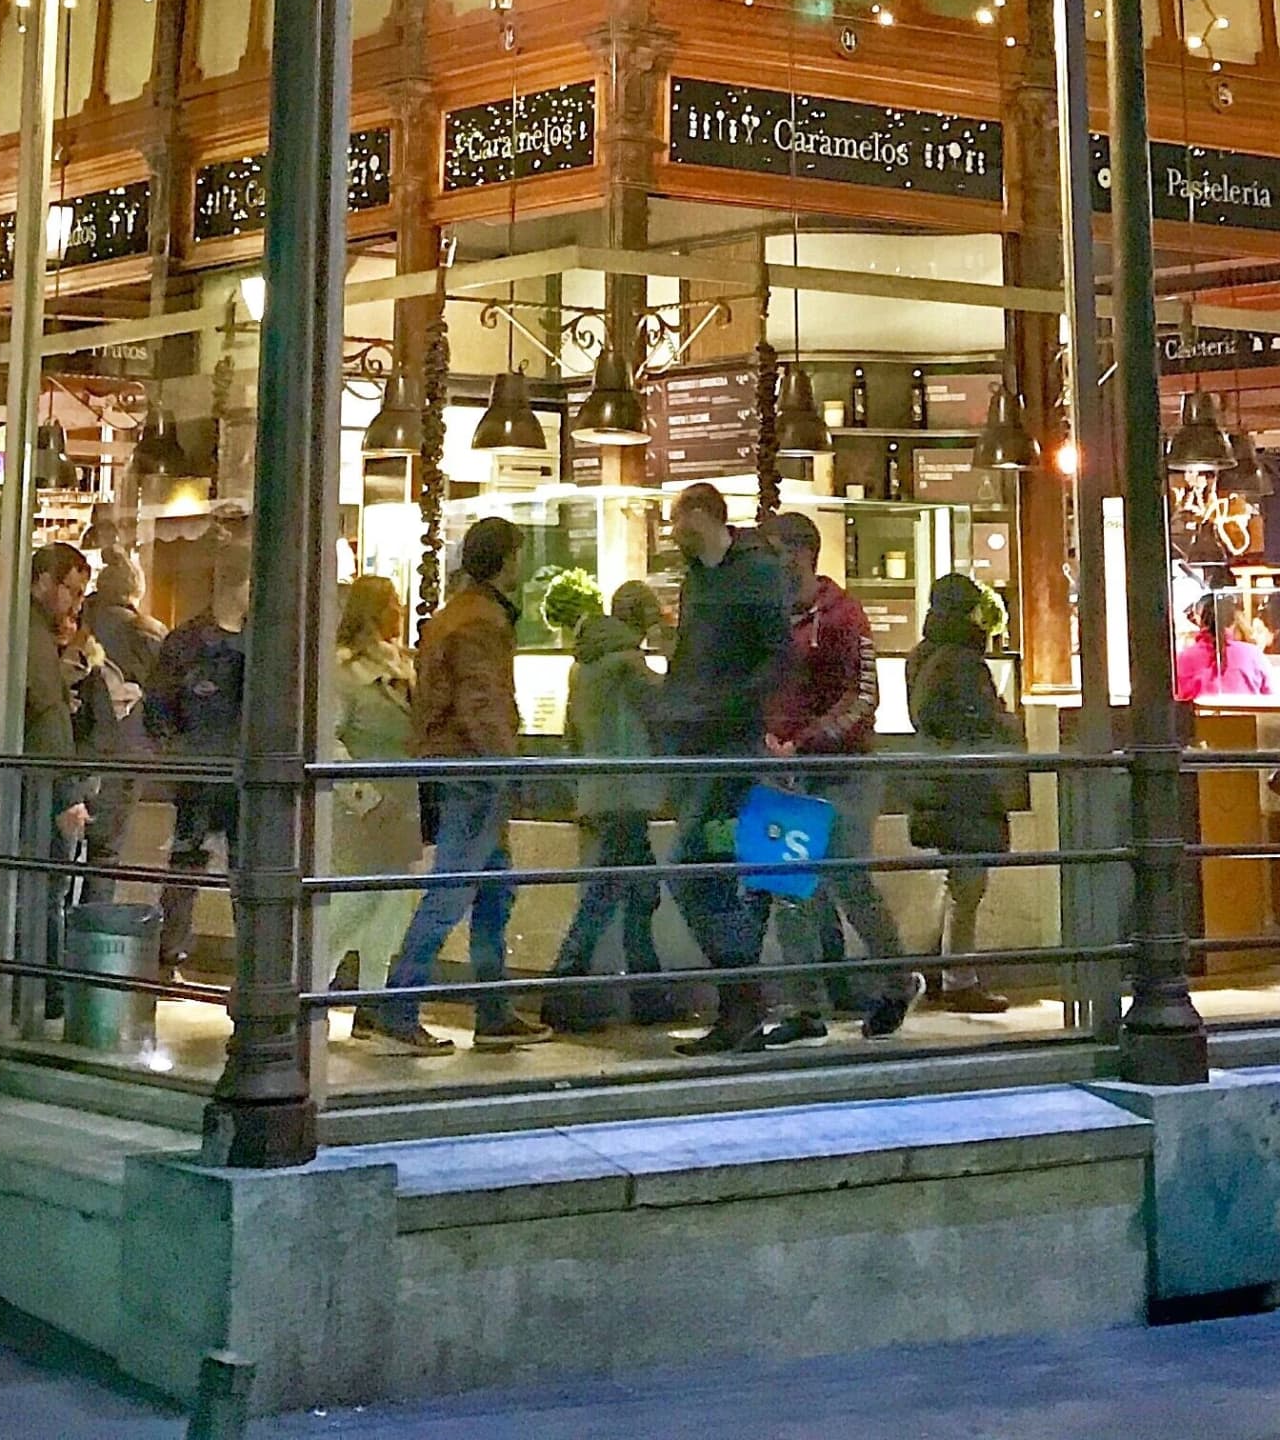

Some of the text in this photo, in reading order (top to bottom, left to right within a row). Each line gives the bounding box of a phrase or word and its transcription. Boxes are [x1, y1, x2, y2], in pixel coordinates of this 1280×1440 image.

[469, 117, 572, 161] Caramelos
[774, 118, 910, 166] Caramelos
[1166, 167, 1272, 208] Pastelería
